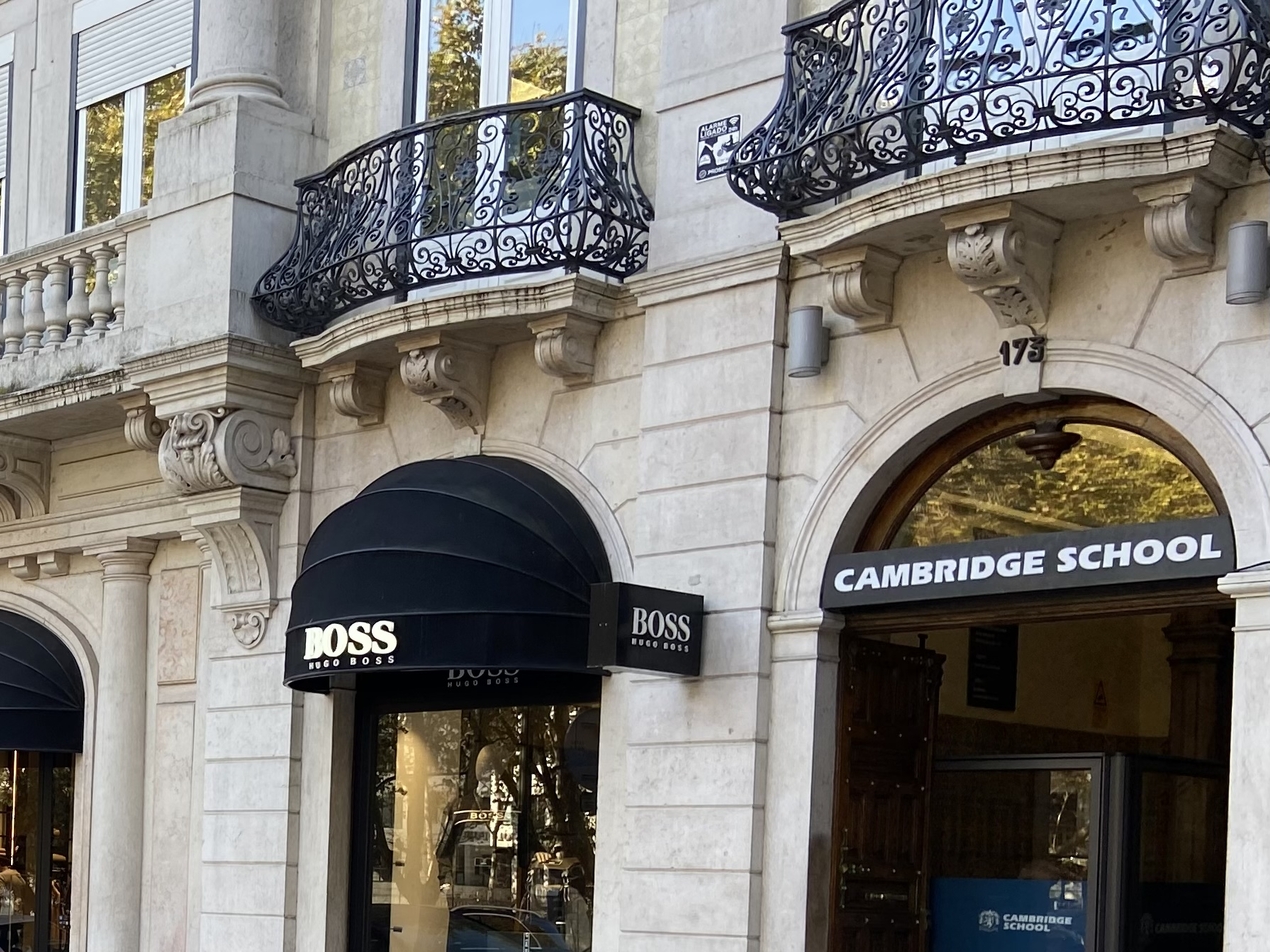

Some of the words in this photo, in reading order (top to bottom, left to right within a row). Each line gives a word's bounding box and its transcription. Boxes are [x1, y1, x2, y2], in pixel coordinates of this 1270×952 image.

[999, 337, 1046, 366] 173
[833, 550, 1047, 592] CAMBRIDGE
[1056, 534, 1222, 573] SCHOOL
[632, 607, 691, 642] BOSS
[303, 620, 398, 660] BOSS
[631, 638, 658, 648] HUGO
[663, 642, 689, 653] BOSS
[308, 658, 340, 670] HUGO
[350, 655, 395, 666] BOSS
[447, 679, 479, 688] HUGO
[487, 676, 519, 686] BOSS
[1002, 913, 1072, 926] CAMBRIDGE
[1002, 922, 1051, 932] SCHOOL
